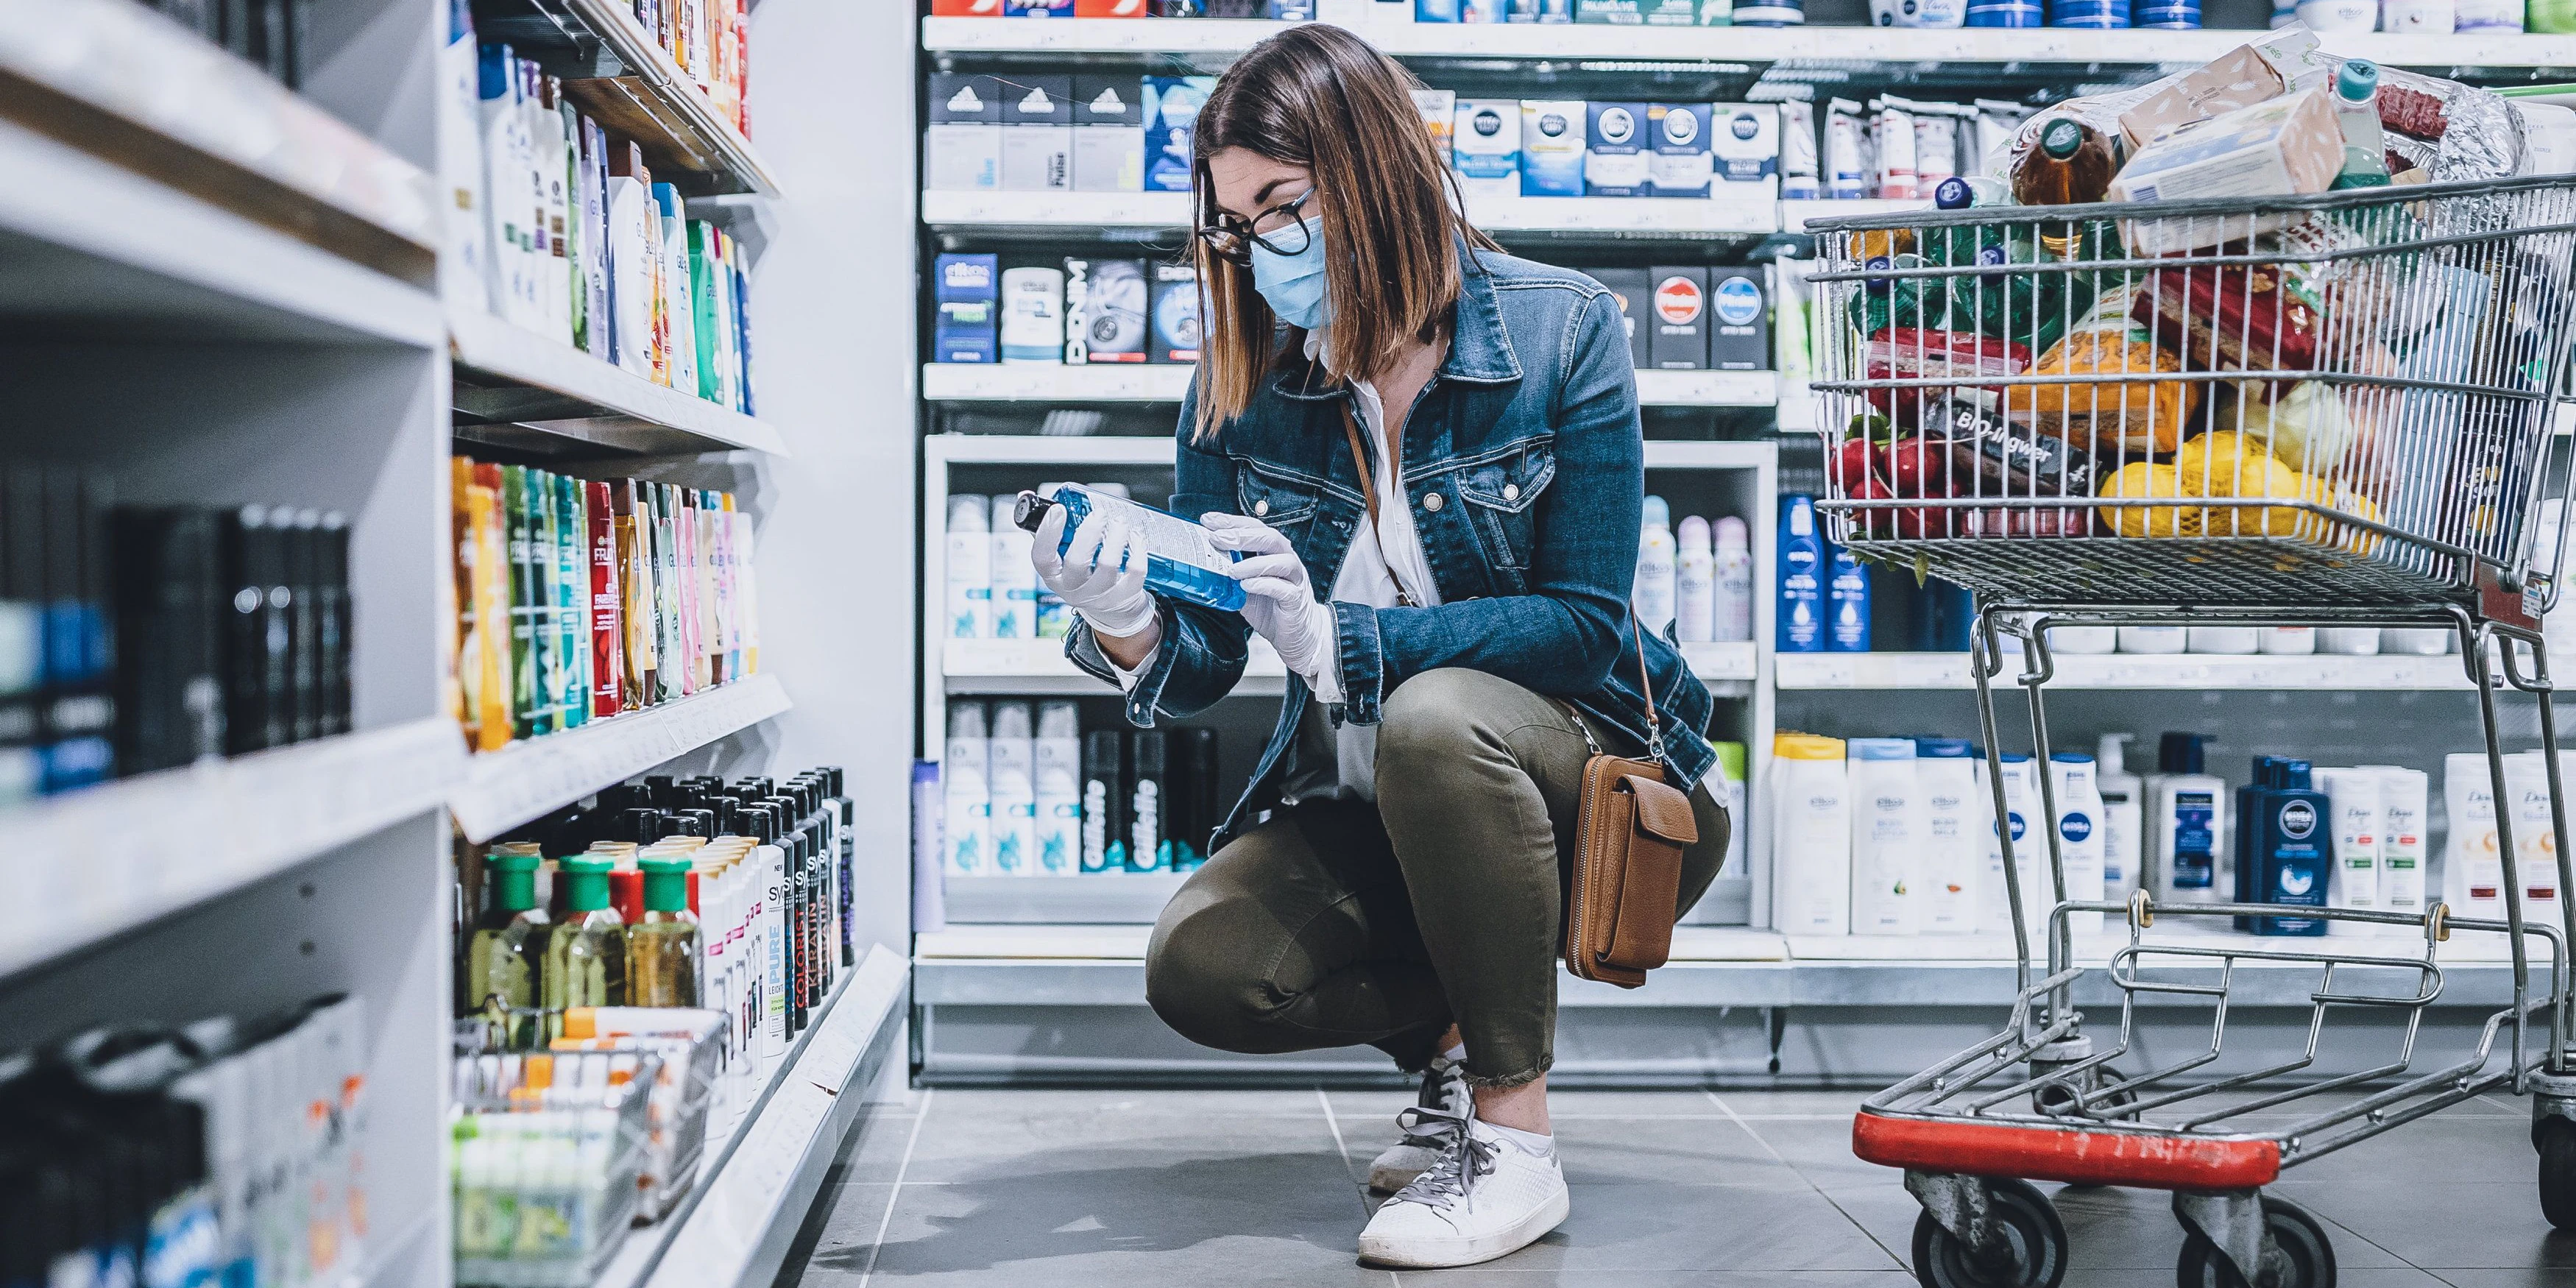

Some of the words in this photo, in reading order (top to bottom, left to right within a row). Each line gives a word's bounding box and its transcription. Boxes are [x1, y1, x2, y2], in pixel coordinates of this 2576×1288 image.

[768, 924, 780, 985] PURE
[796, 907, 805, 1009] COLORIST
[809, 902, 818, 987] KERATIN
